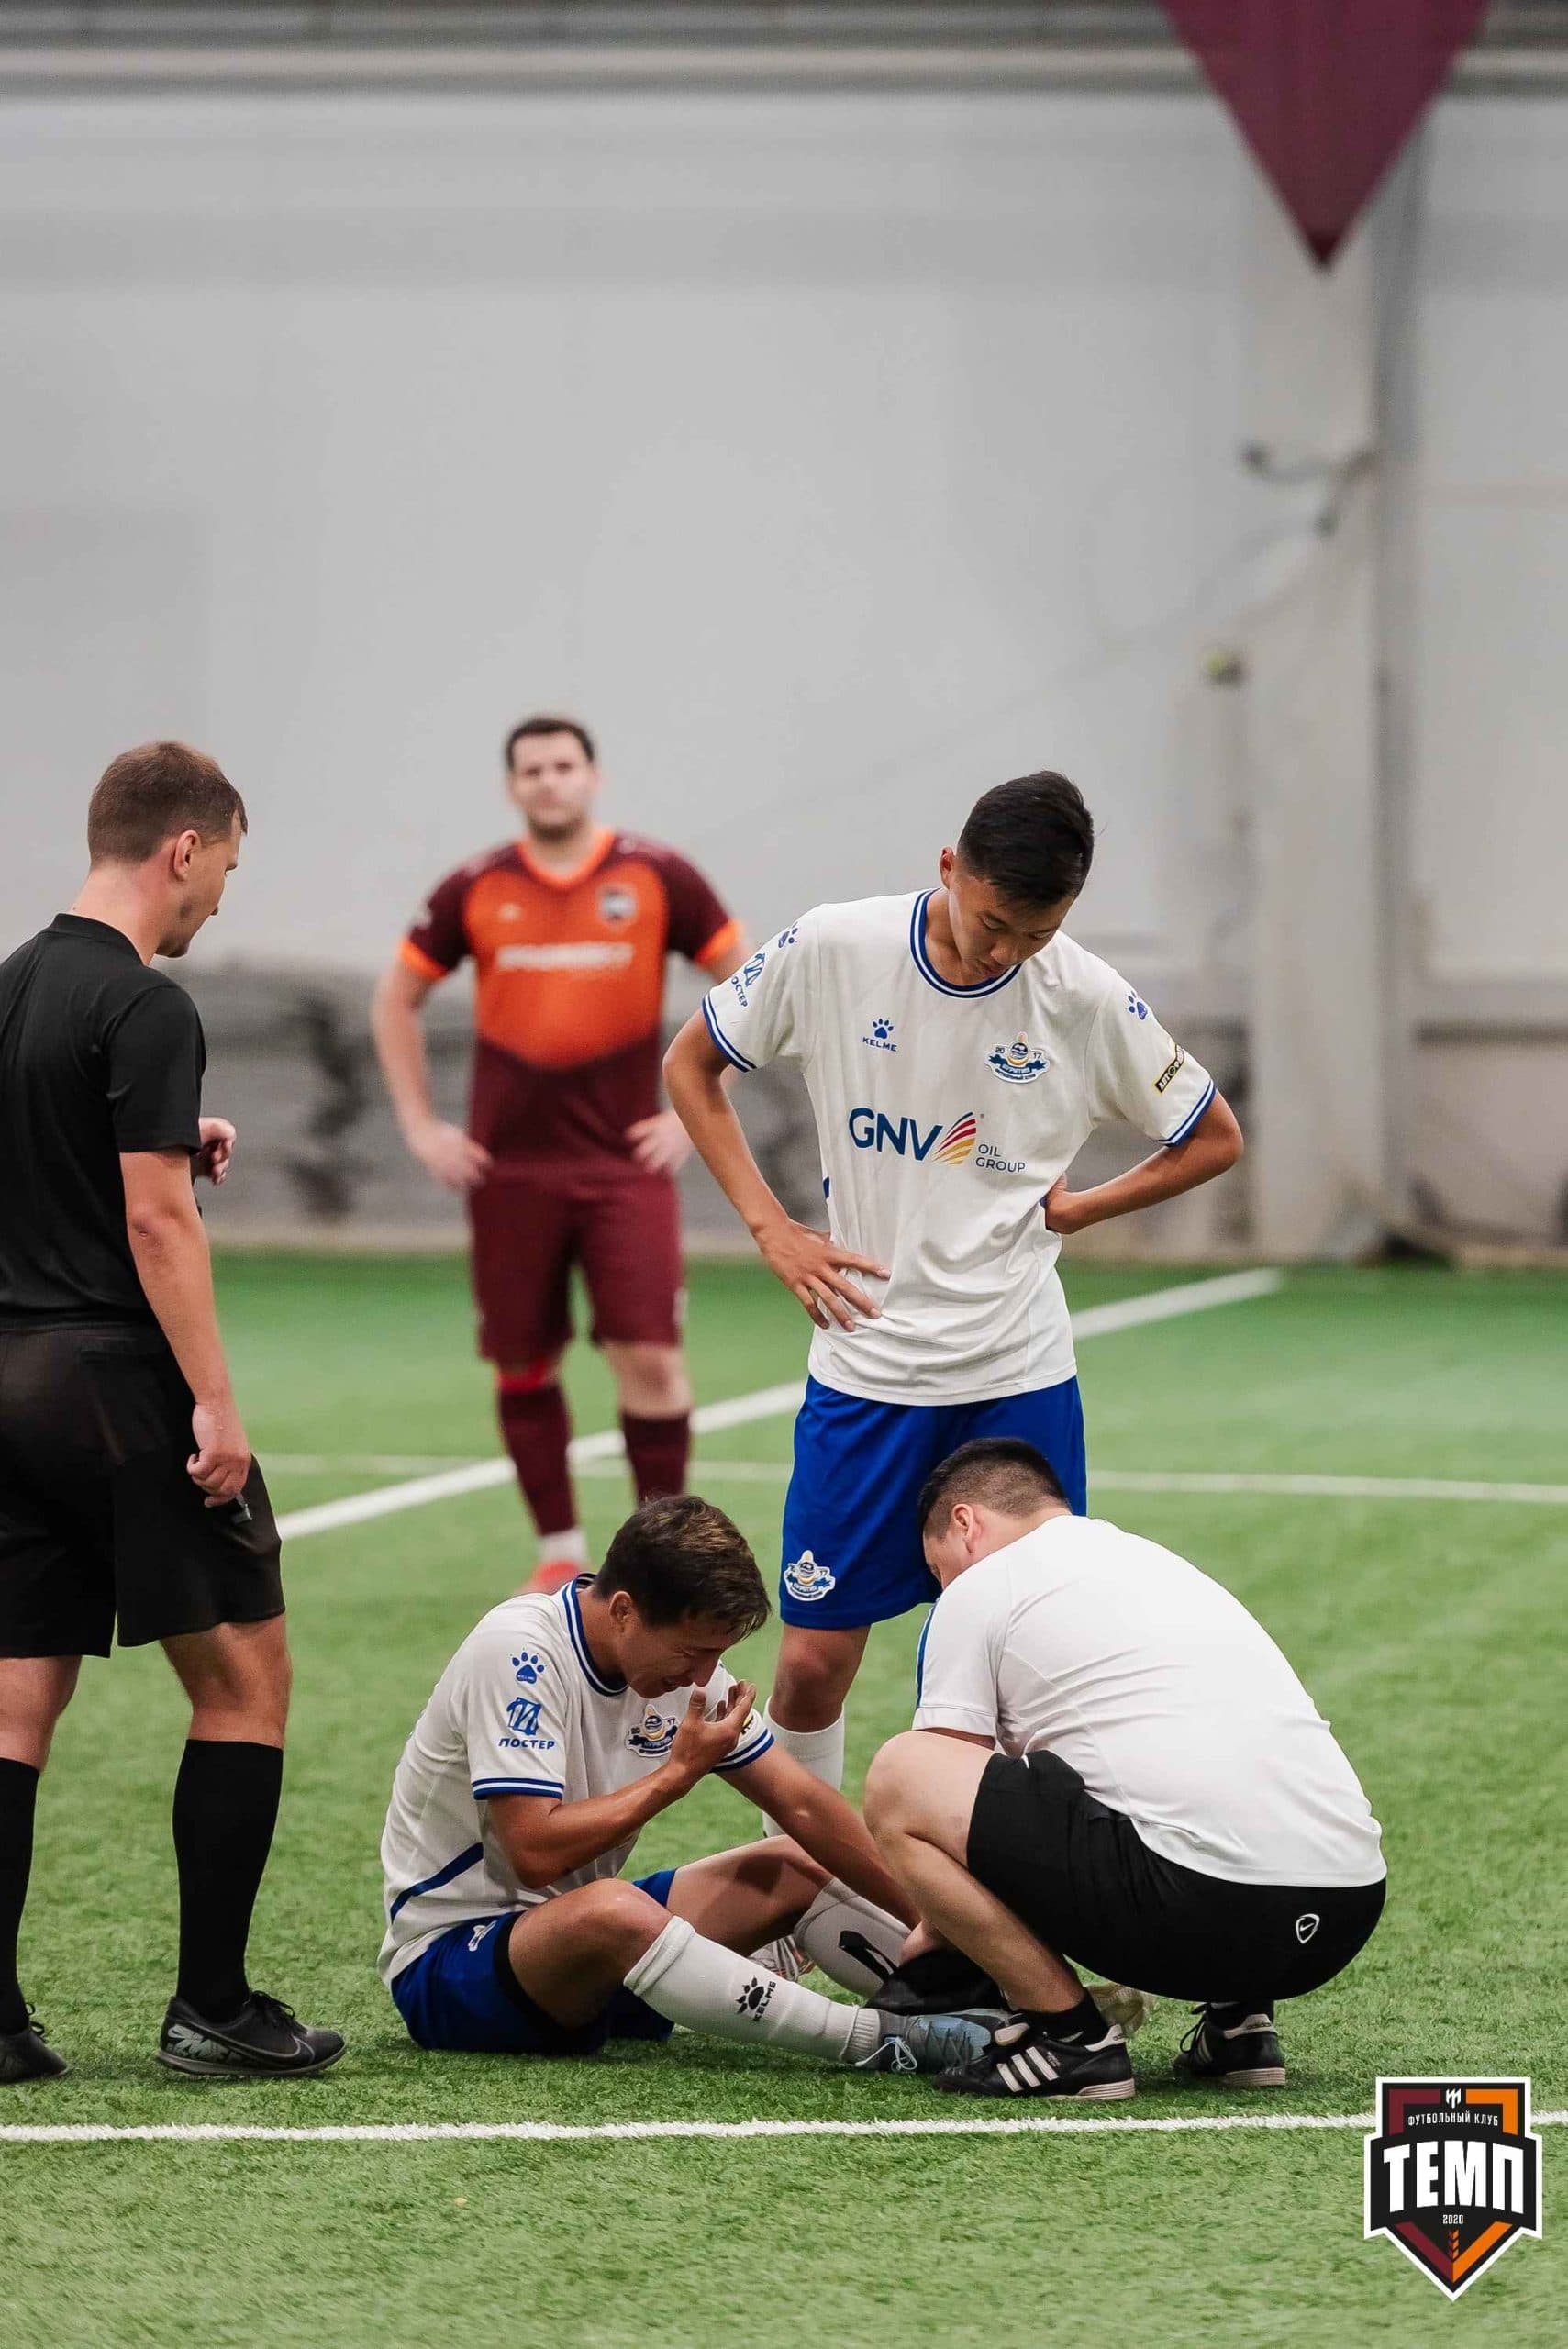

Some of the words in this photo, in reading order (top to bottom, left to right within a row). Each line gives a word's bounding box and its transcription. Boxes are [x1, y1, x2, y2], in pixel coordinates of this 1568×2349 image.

[730, 975, 748, 1008] ОСТЕР
[862, 1037, 897, 1052] KELME
[849, 1107, 943, 1161] GNV
[978, 1144, 1001, 1157] OIL
[975, 1157, 1026, 1173] GROUP
[498, 1738, 555, 1750] ПОСТЕР
[753, 1981, 776, 2021] KELME
